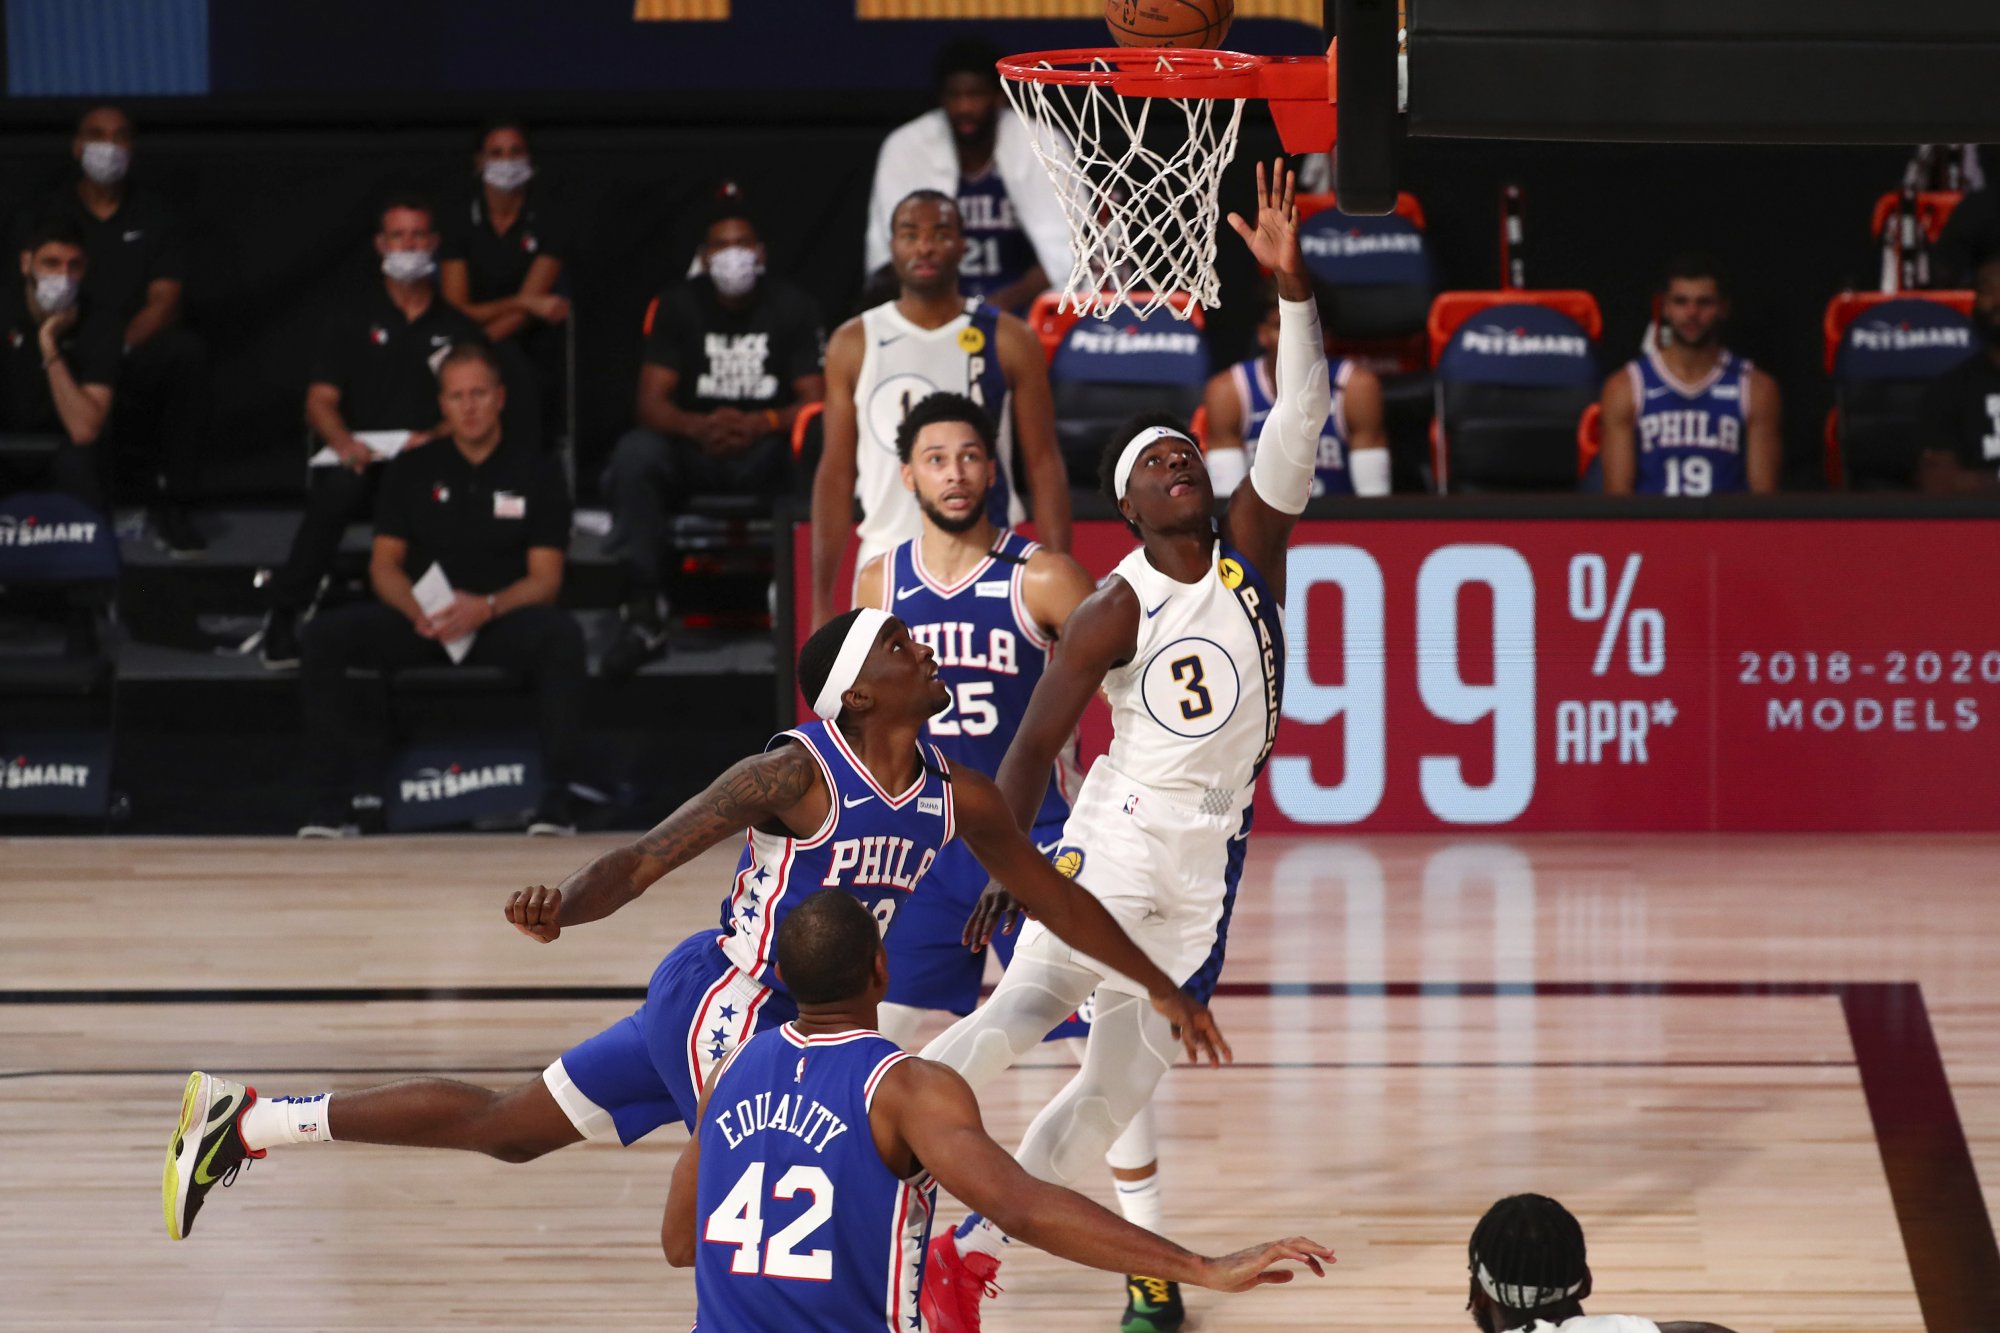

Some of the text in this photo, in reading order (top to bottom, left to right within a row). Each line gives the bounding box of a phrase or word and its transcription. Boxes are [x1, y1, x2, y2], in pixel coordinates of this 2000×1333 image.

[958, 237, 999, 274] 21
[1640, 409, 1740, 454] PHILA
[1664, 456, 1713, 497] 19
[908, 621, 1020, 675] HILA
[1738, 651, 2000, 684] 2018-2020
[1169, 654, 1214, 722] 3
[1268, 544, 1666, 824] 99 %
[1766, 698, 1980, 732] MODELS
[401, 763, 525, 801] PETSMART
[820, 835, 937, 893] PHILA
[715, 1091, 848, 1154] EQUALITY
[703, 1161, 834, 1282] 42
